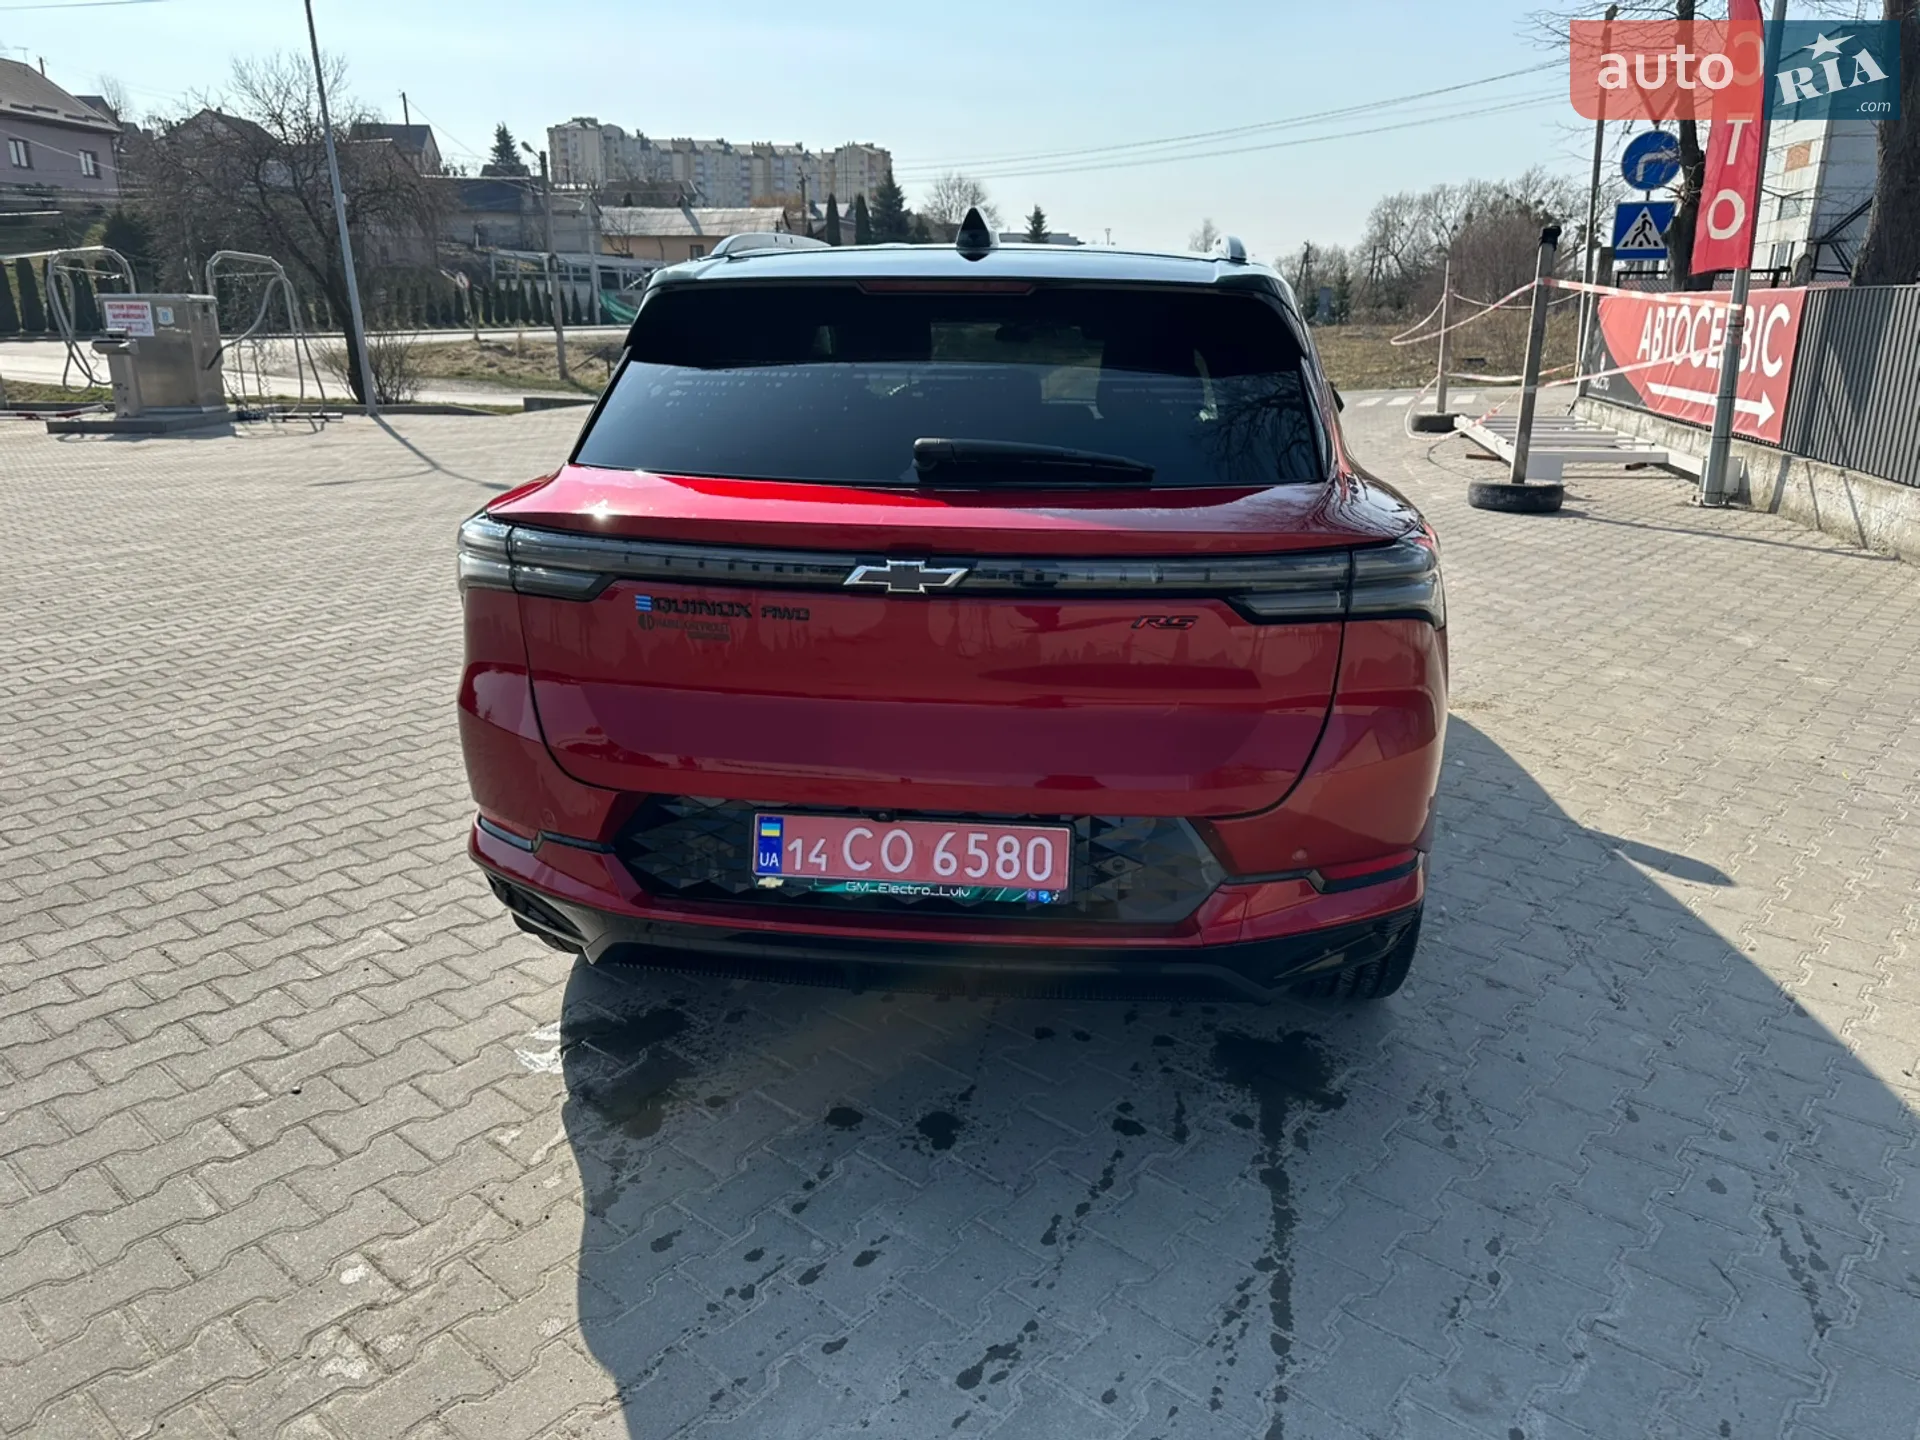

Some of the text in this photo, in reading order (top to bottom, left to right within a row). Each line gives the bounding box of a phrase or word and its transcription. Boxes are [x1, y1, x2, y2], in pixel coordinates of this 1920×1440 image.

[1637, 303, 1791, 378] АВТОСЕВІС
[1131, 614, 1199, 630] RS
[759, 851, 780, 868] UA
[787, 827, 1053, 882] 14 CO 6580
